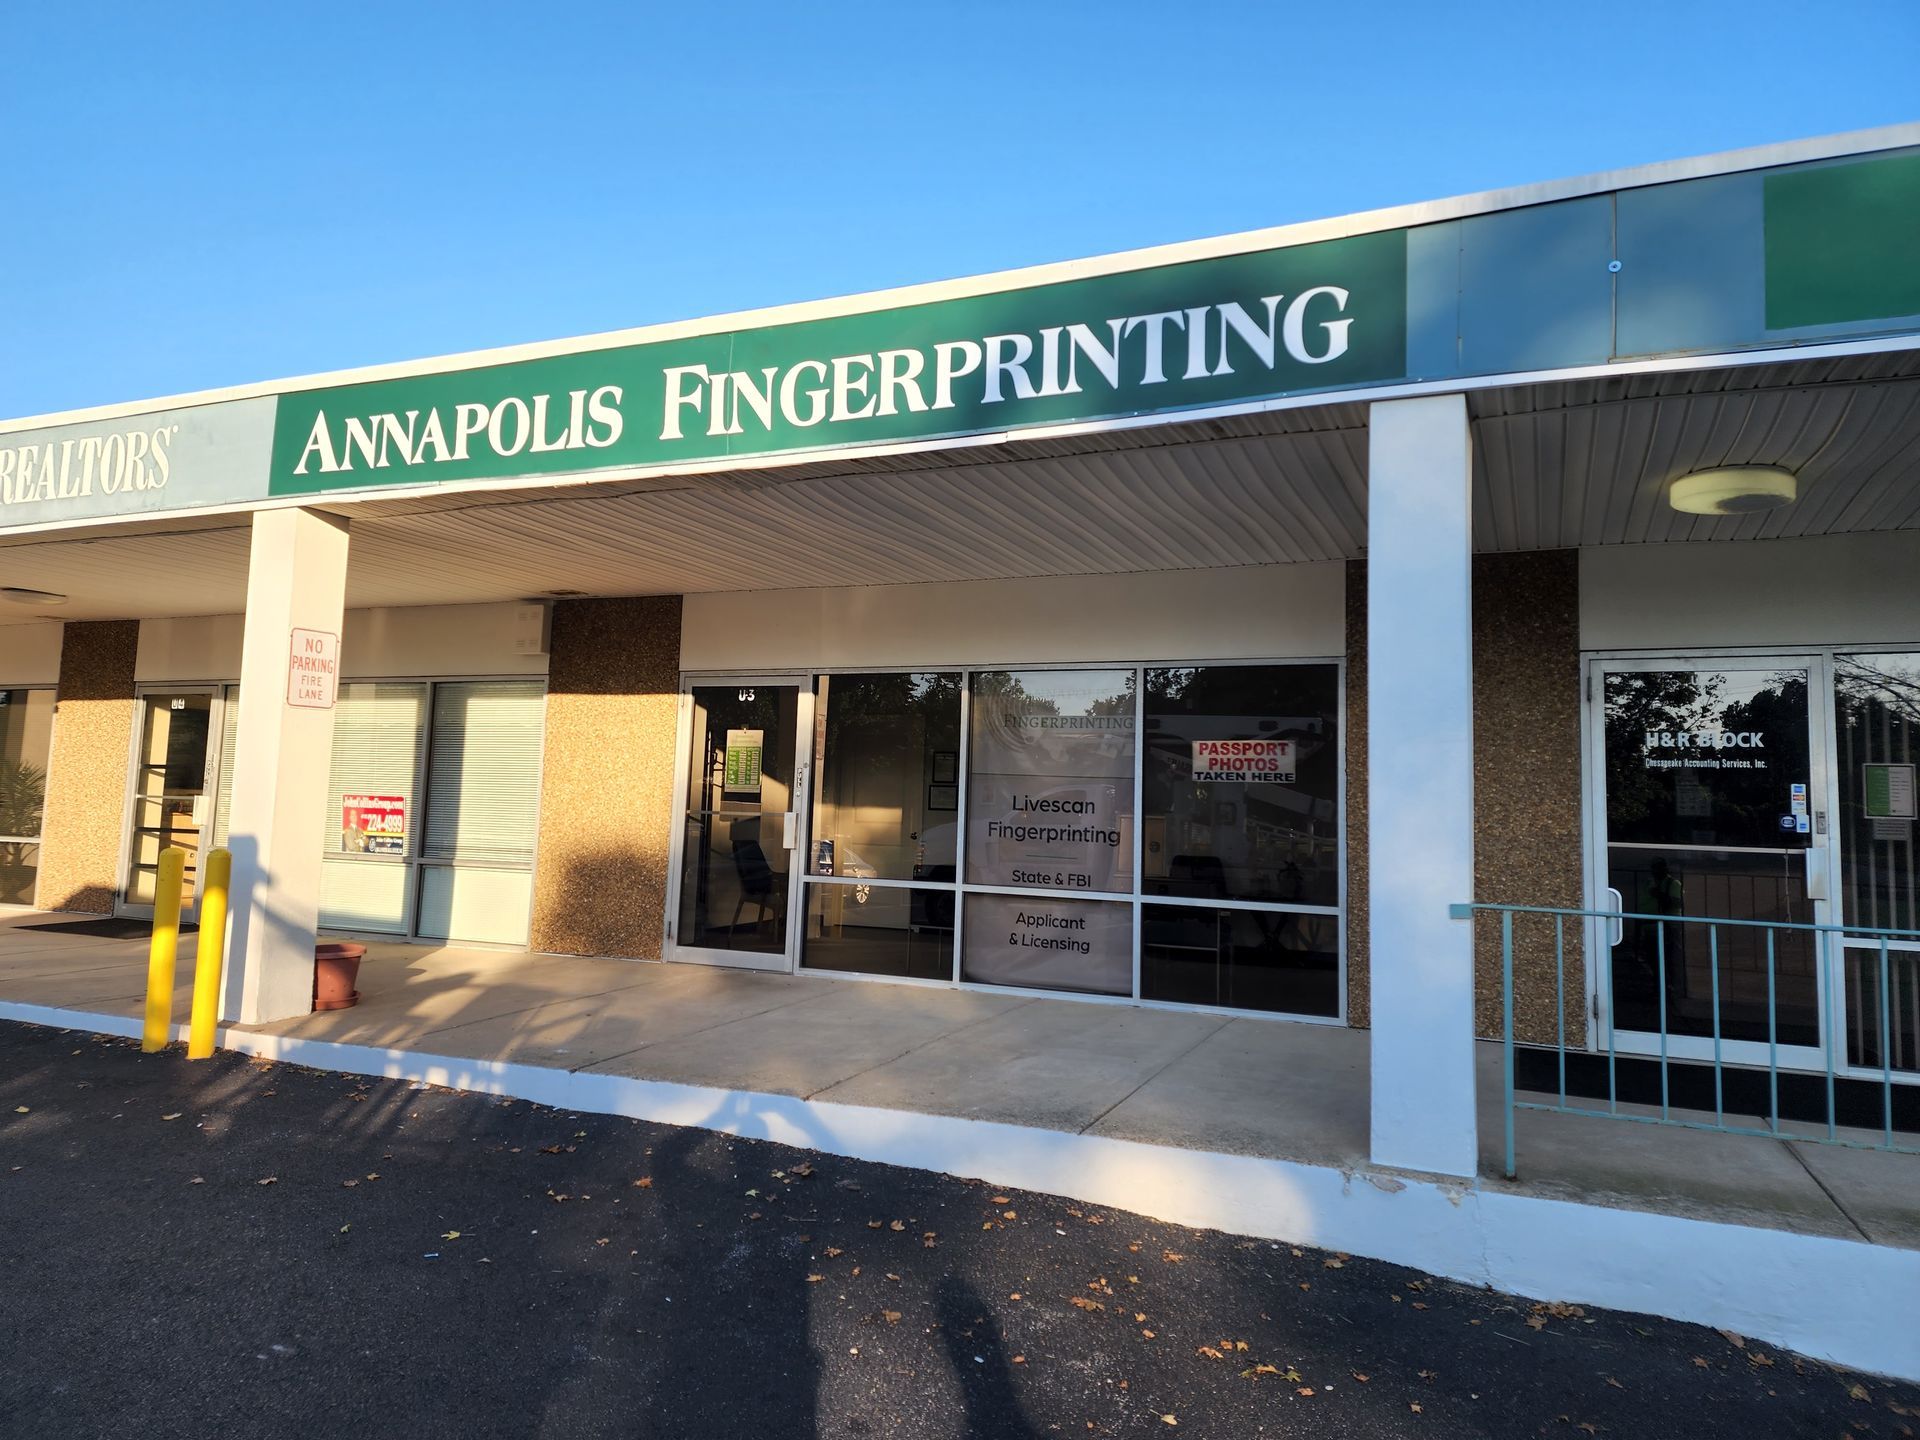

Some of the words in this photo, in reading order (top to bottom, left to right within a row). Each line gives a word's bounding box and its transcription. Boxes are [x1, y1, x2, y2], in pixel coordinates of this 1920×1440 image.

[293, 385, 624, 475] ANNAPOLIS
[659, 285, 1355, 440] FINGERPRINTING
[305, 638, 323, 654] NO
[292, 655, 334, 674] PARKING
[301, 675, 323, 687] FIRE
[298, 689, 324, 700] LANE
[1004, 713, 1134, 729] FINGERPRINTING
[1646, 732, 1690, 747] H&R
[1698, 732, 1765, 748] BLOCK
[1198, 742, 1289, 756] PASSPORT
[1208, 758, 1279, 771] PHOTOS
[1684, 758, 1720, 769] Accounting
[1722, 759, 1753, 769] Services,
[1755, 759, 1768, 768] Inc.
[1194, 772, 1246, 781] TAKEN
[1251, 772, 1296, 782] HERE
[1012, 795, 1095, 814] Livescan
[367, 814, 403, 832] 224-4999
[988, 821, 1121, 847] Fingerprinting
[1012, 869, 1051, 885] State
[1055, 872, 1064, 885] &
[1067, 872, 1091, 888] FBI
[1015, 911, 1085, 931] Applicant
[1009, 932, 1018, 945] &
[1021, 932, 1091, 955] Licensing
